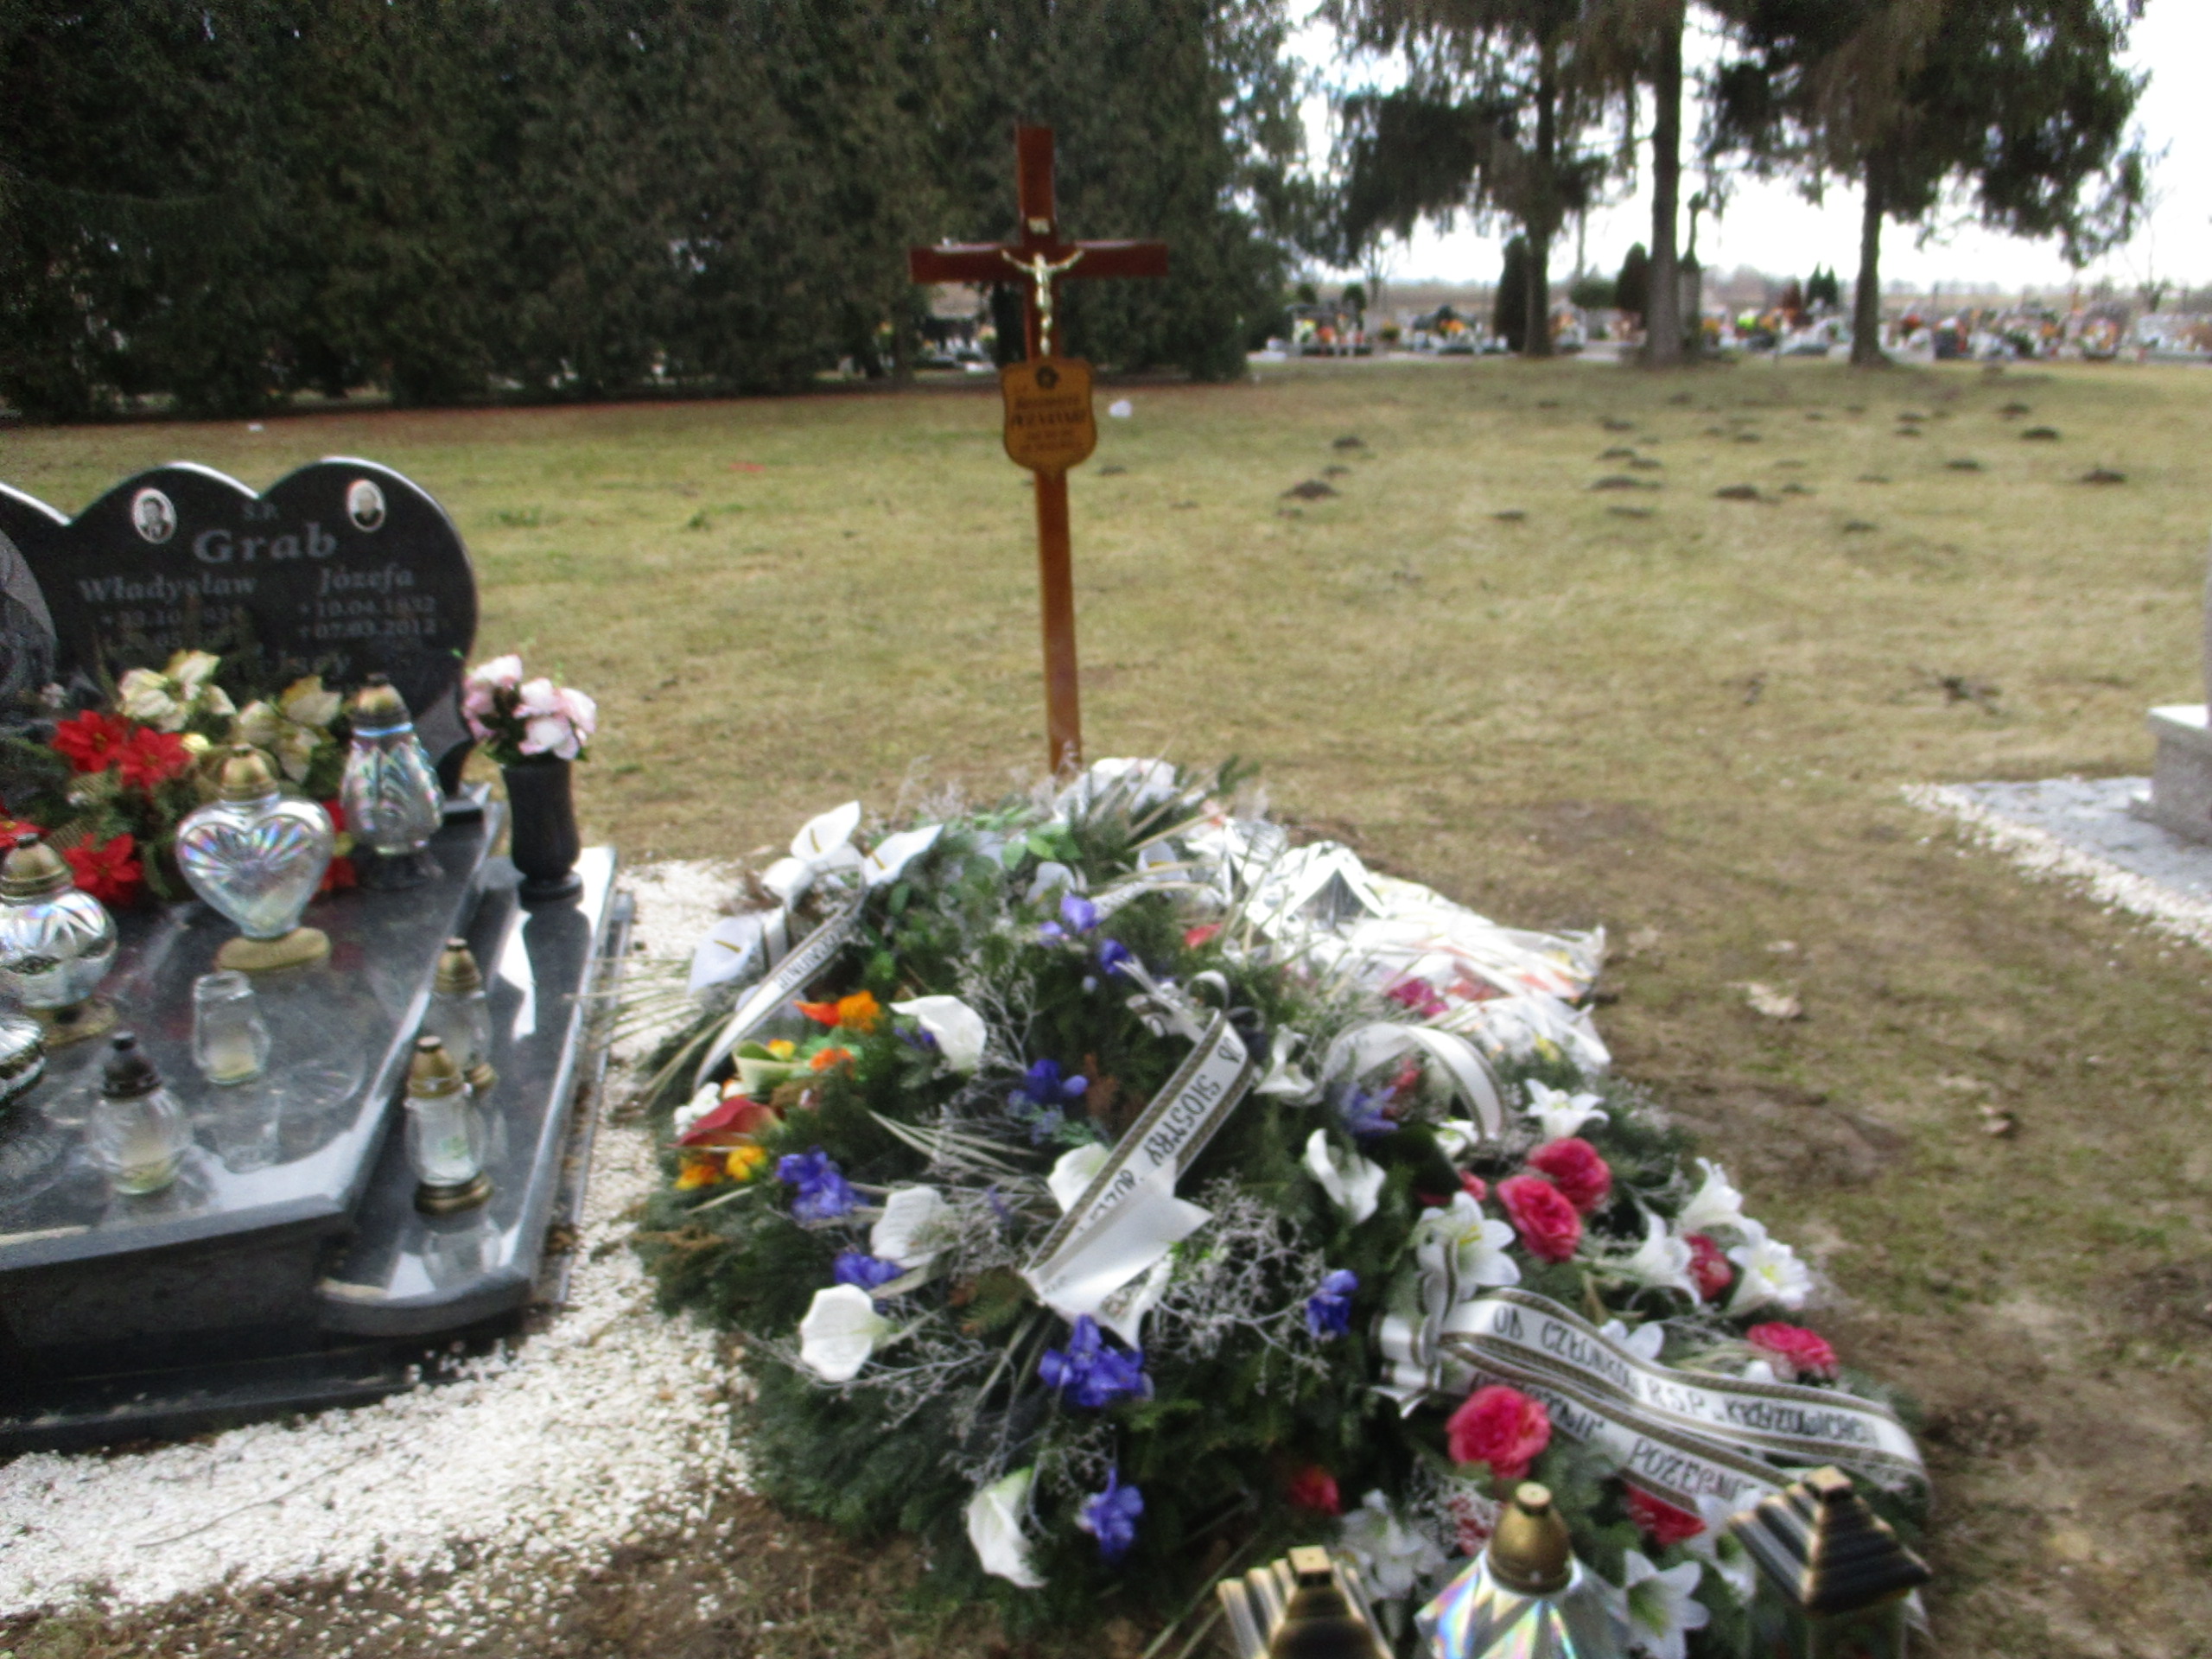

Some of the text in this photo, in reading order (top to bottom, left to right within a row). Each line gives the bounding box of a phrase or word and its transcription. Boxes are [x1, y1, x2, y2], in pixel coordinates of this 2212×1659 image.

[193, 522, 338, 563] Grab
[320, 563, 416, 595] Józefa
[1143, 1074, 1221, 1166] SIOSTRY
